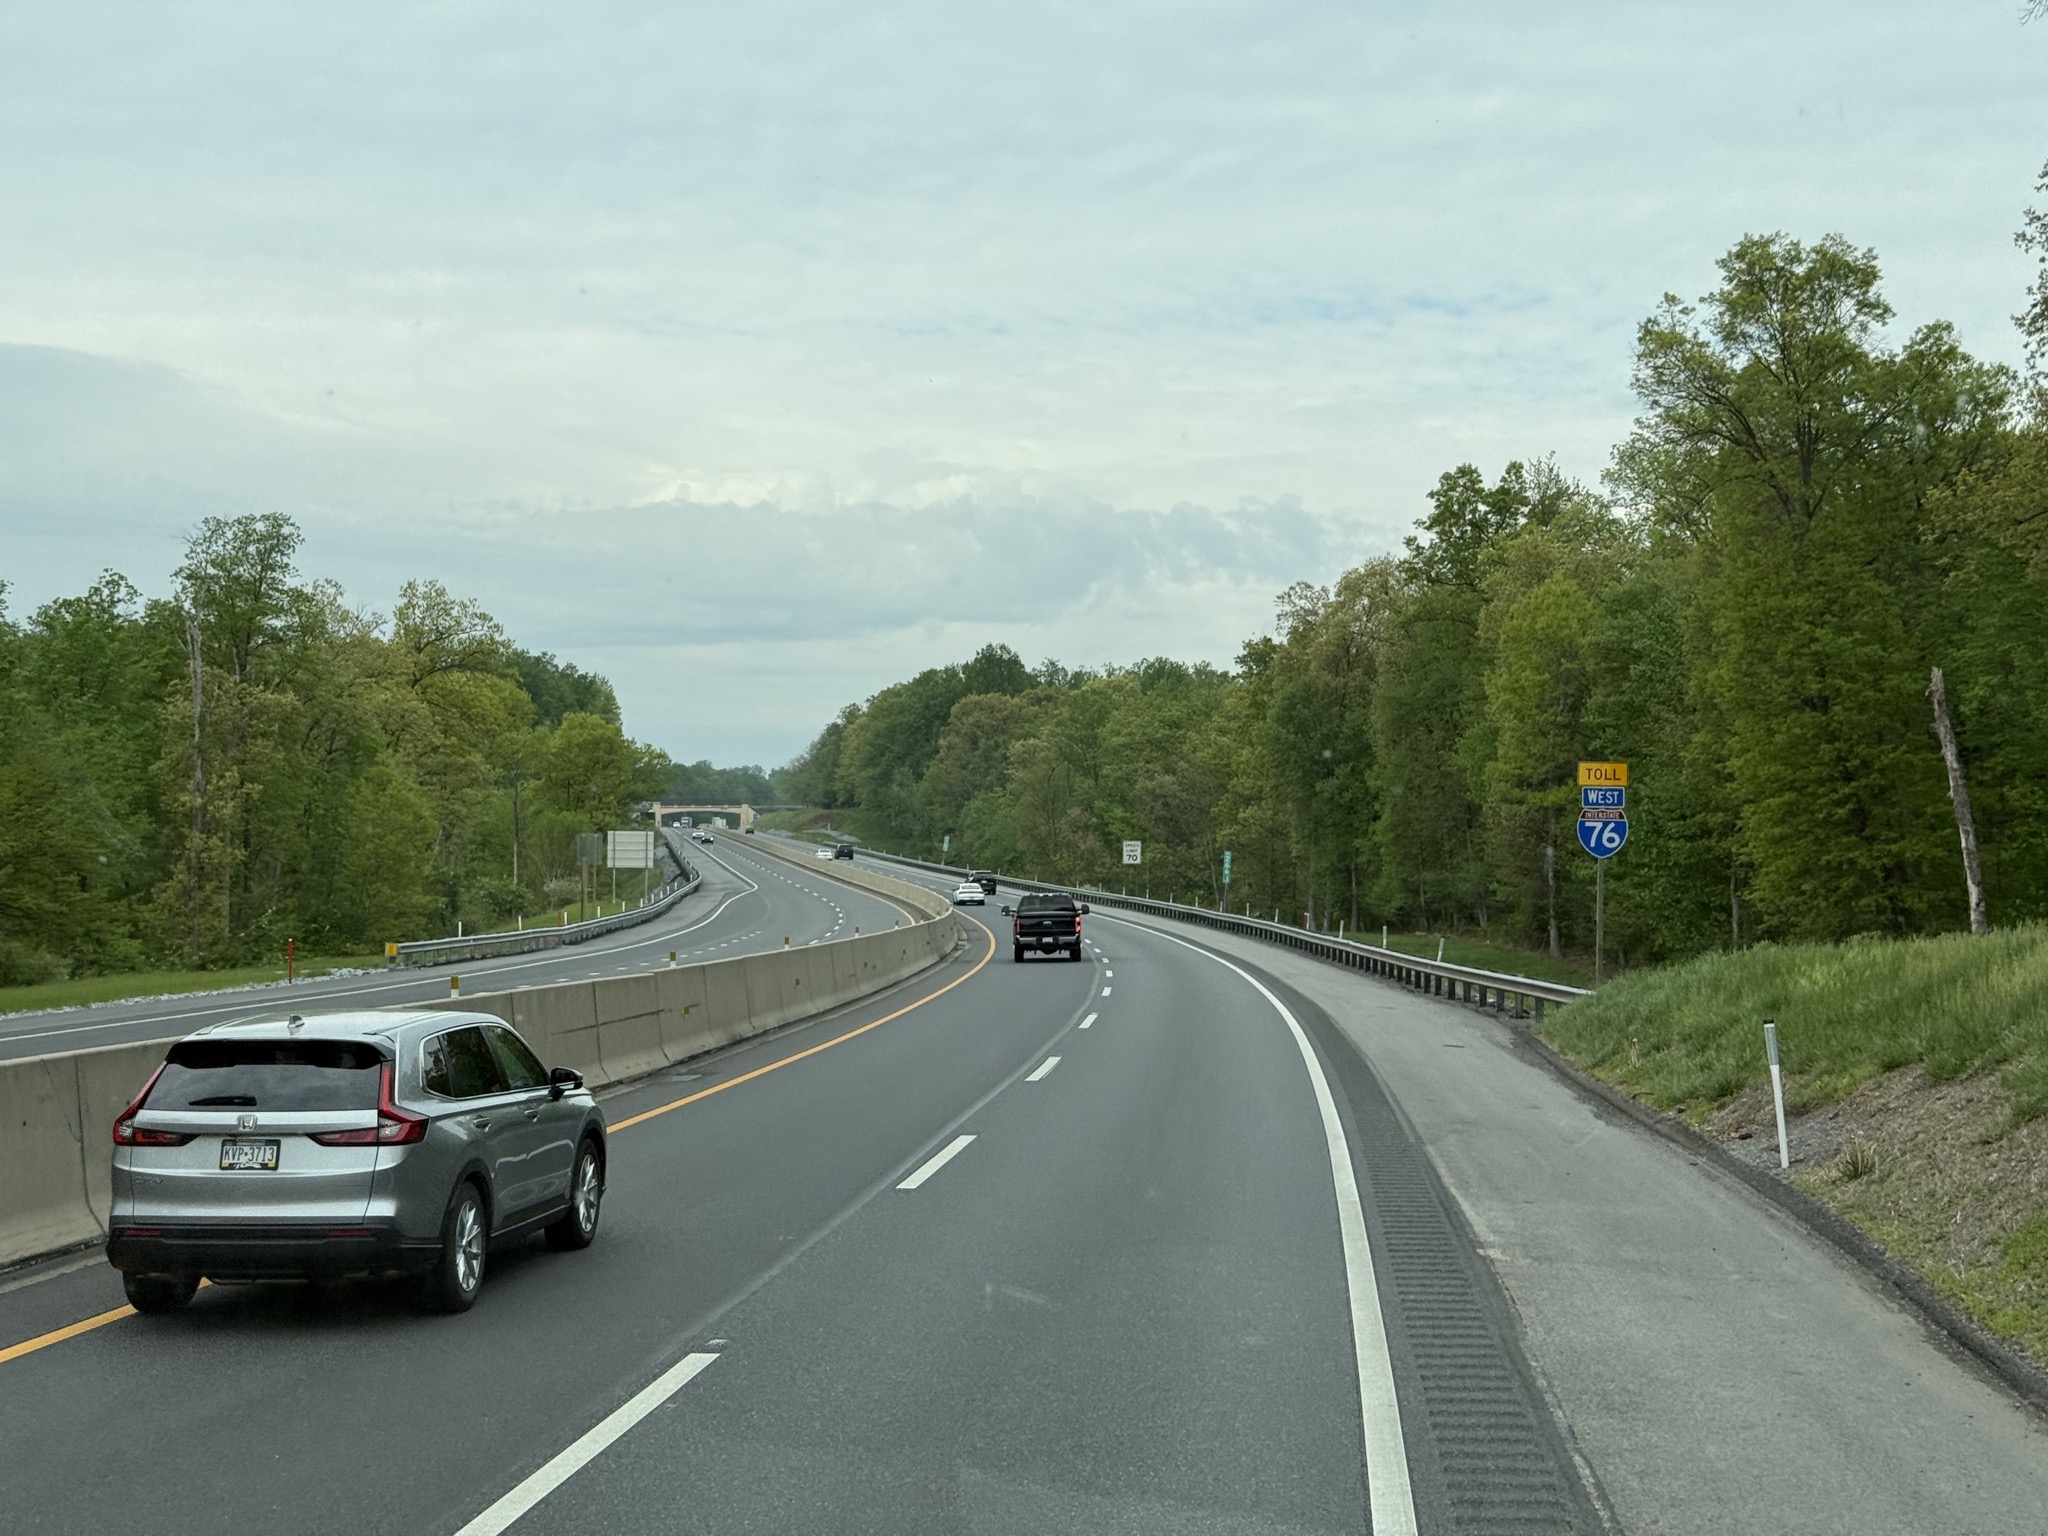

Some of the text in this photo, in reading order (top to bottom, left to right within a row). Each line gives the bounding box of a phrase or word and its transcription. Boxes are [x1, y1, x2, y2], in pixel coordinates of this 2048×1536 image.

[1586, 768, 1621, 781] TOLL
[1588, 789, 1619, 804] WEST
[1585, 811, 1620, 819] INTERSTATE
[1584, 821, 1620, 849] 76
[1126, 854, 1138, 862] 70
